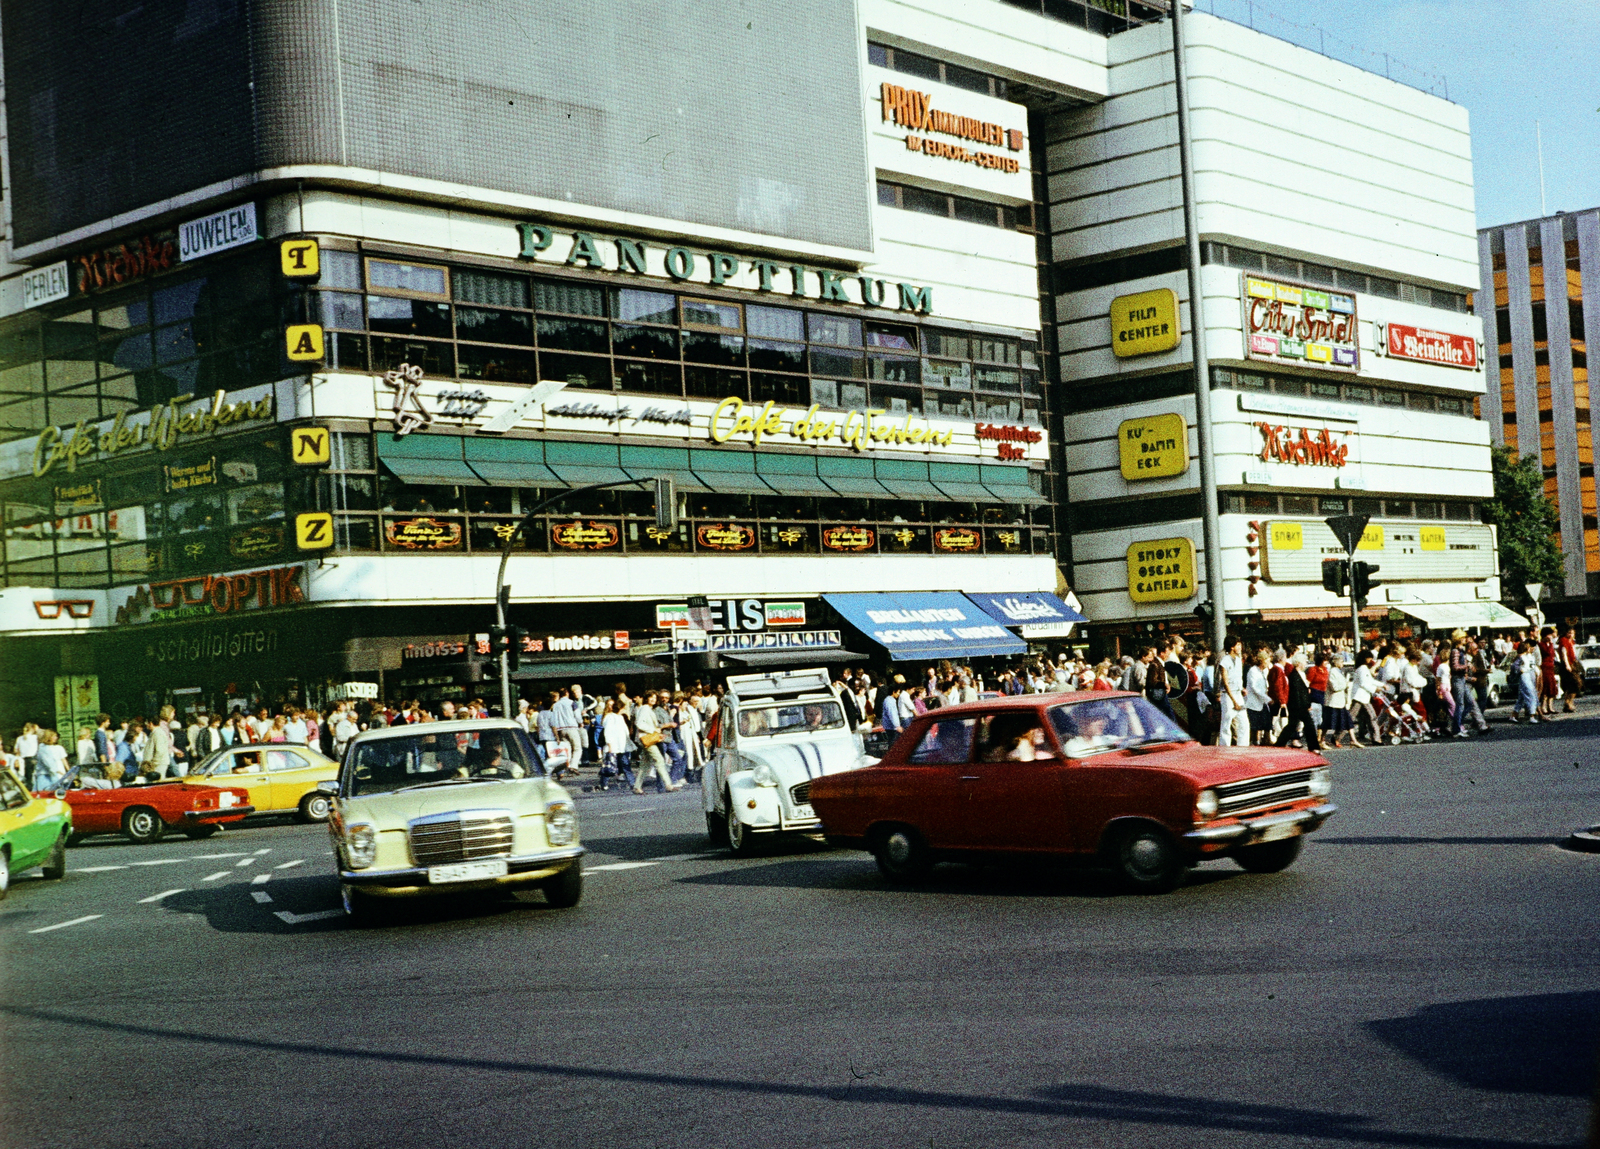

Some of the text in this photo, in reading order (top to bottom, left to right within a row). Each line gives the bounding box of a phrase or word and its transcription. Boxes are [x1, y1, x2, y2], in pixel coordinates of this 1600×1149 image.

[881, 82, 1004, 146] PROX IMMOBILIEN
[182, 207, 248, 256] JUWELEN
[516, 221, 935, 314] PANOPTIKUM
[24, 269, 67, 302] PERLEN
[1129, 307, 1157, 323] FILM
[1250, 298, 1355, 342] City Spiel
[1119, 323, 1170, 342] CENTER
[33, 390, 272, 477] Café des Westens
[709, 396, 954, 452] Café des Westens
[1141, 438, 1176, 453] DAMM
[1137, 457, 1161, 469] ECK
[1421, 533, 1446, 543] CAMERA
[1137, 547, 1181, 562] SMOKY
[1138, 563, 1181, 578] OSCAR
[211, 566, 304, 613] OPTIK
[1136, 579, 1188, 593] CAMERA
[708, 600, 764, 630] EIS
[404, 643, 465, 658] imbiss
[547, 635, 612, 651] imbiss
